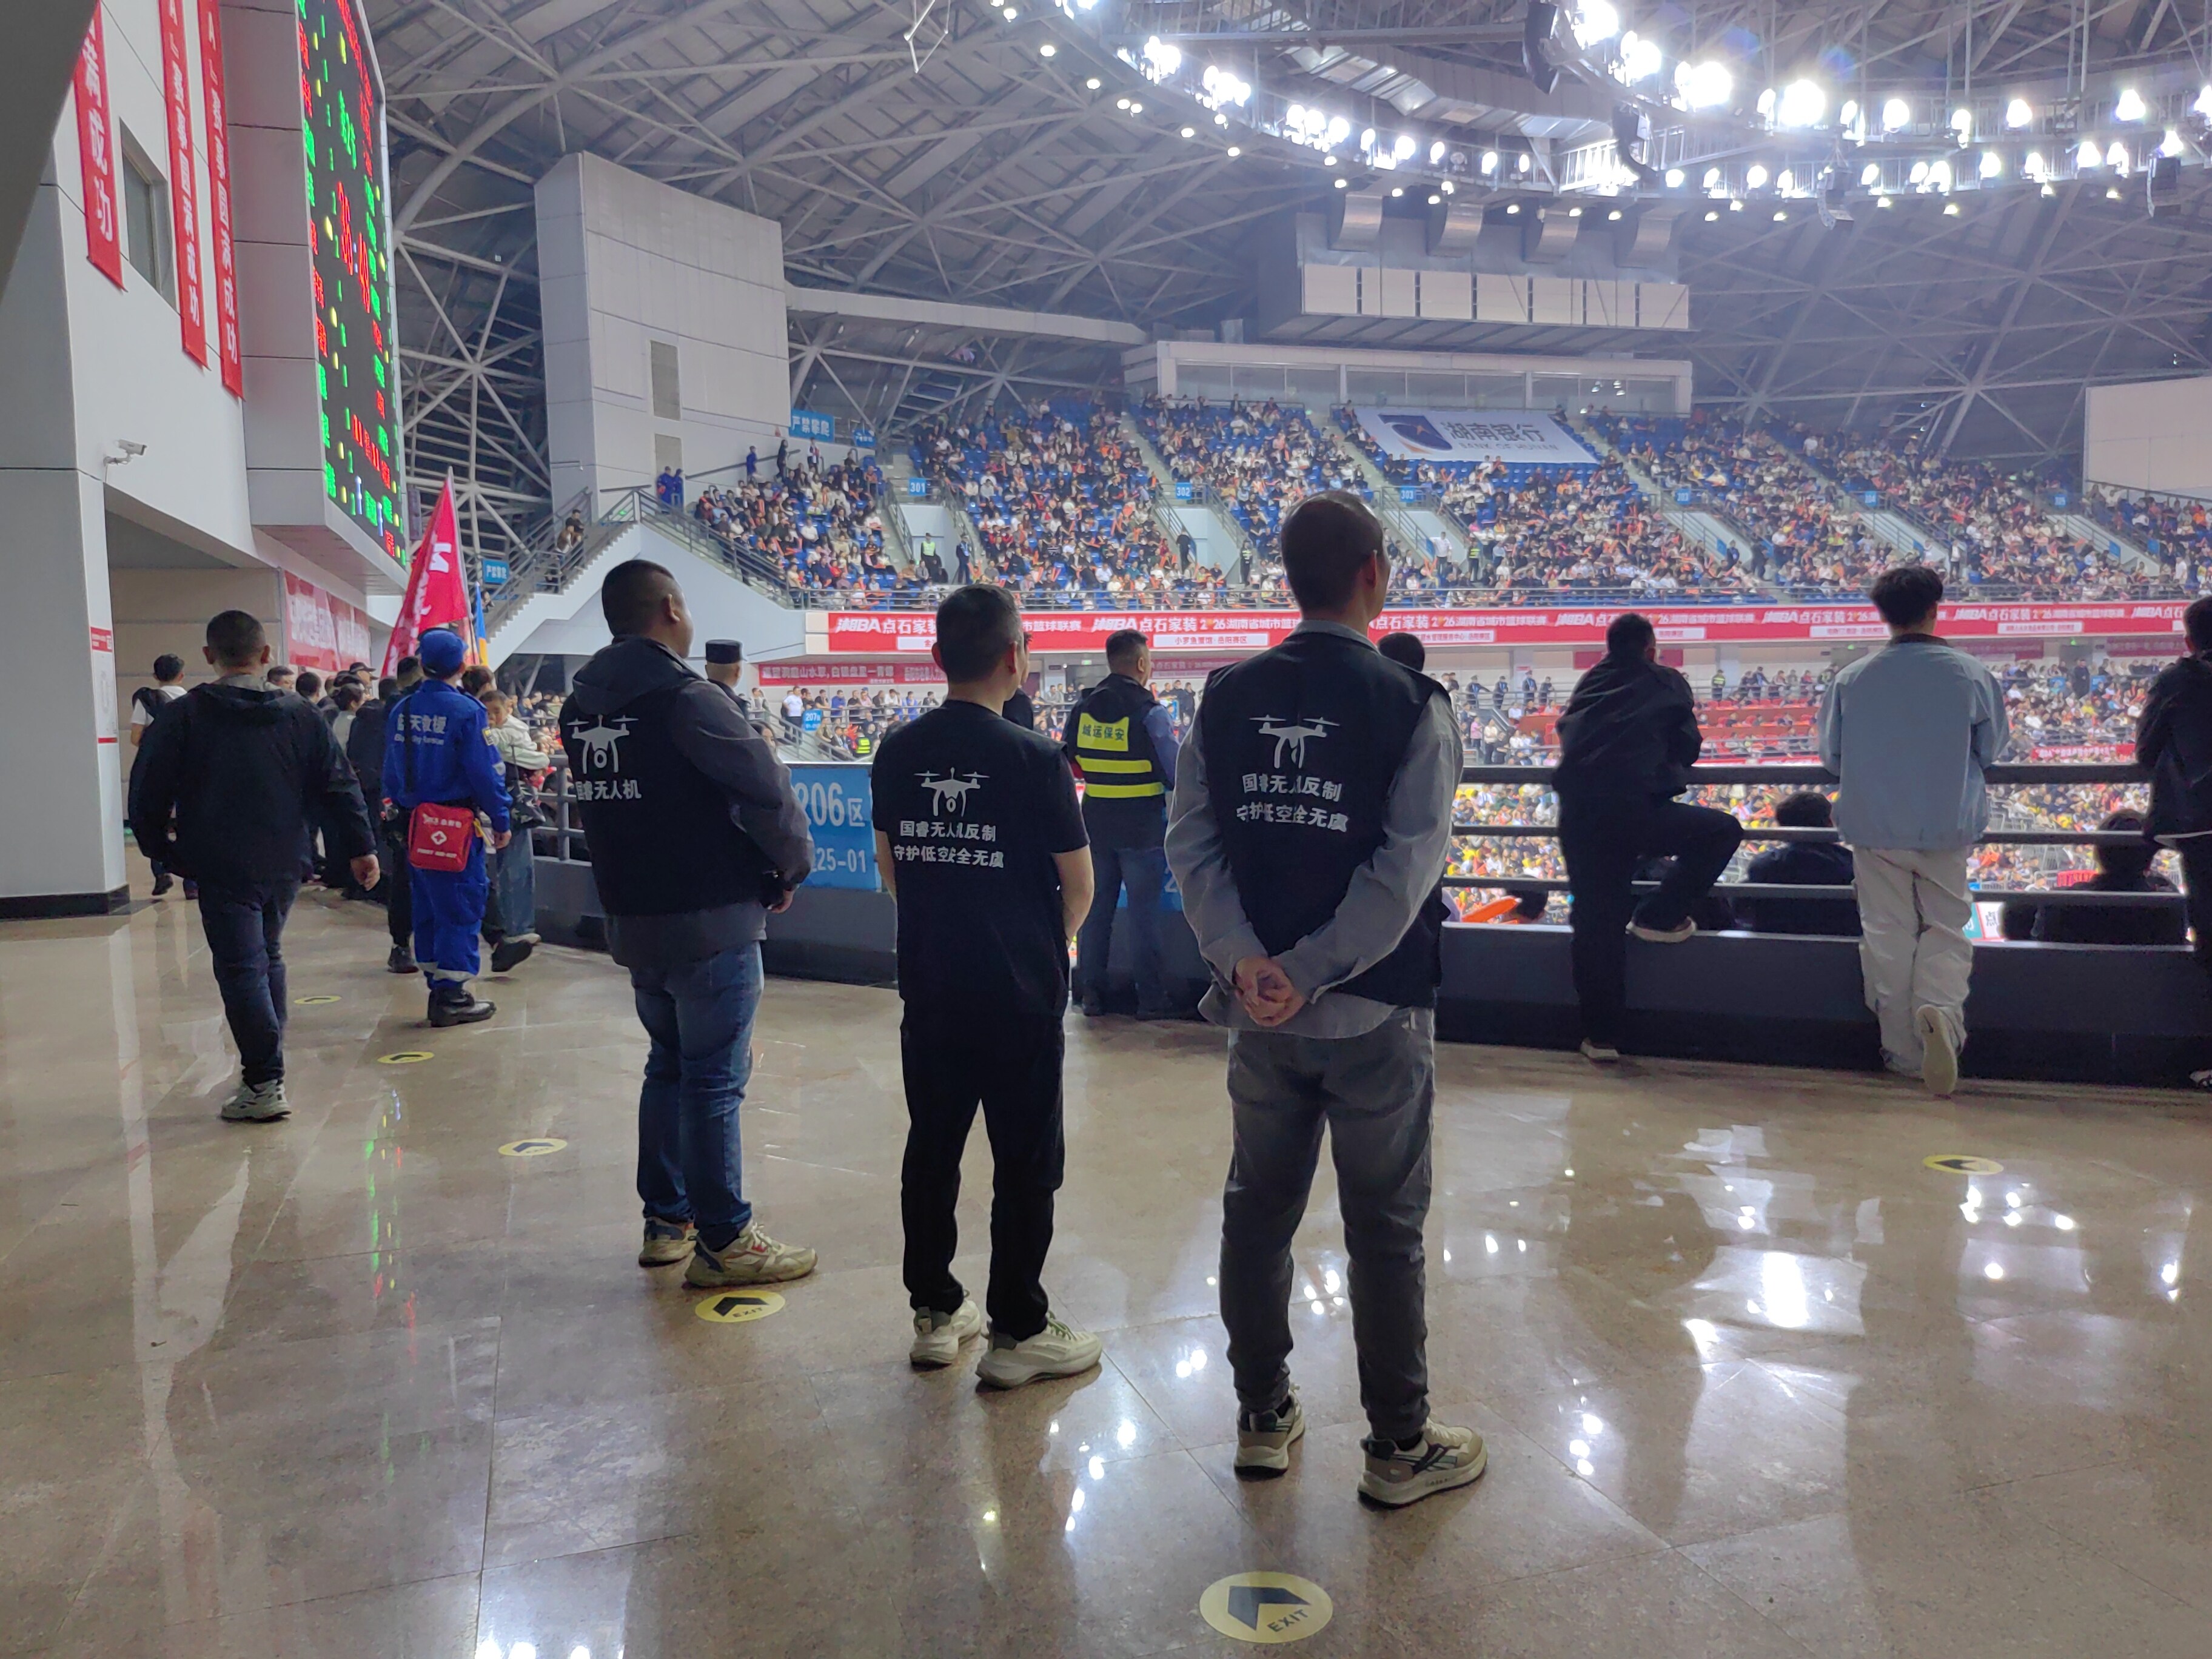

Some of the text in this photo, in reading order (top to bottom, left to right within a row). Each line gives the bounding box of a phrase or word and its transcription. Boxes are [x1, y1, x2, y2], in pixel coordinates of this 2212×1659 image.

[81, 17, 113, 242] 满成功
[1441, 422, 1545, 442] 湖南银行
[910, 483, 925, 492] 301
[1176, 487, 1190, 497] 302
[732, 1307, 763, 1318] EXIT
[1267, 1609, 1309, 1632] EXIT
